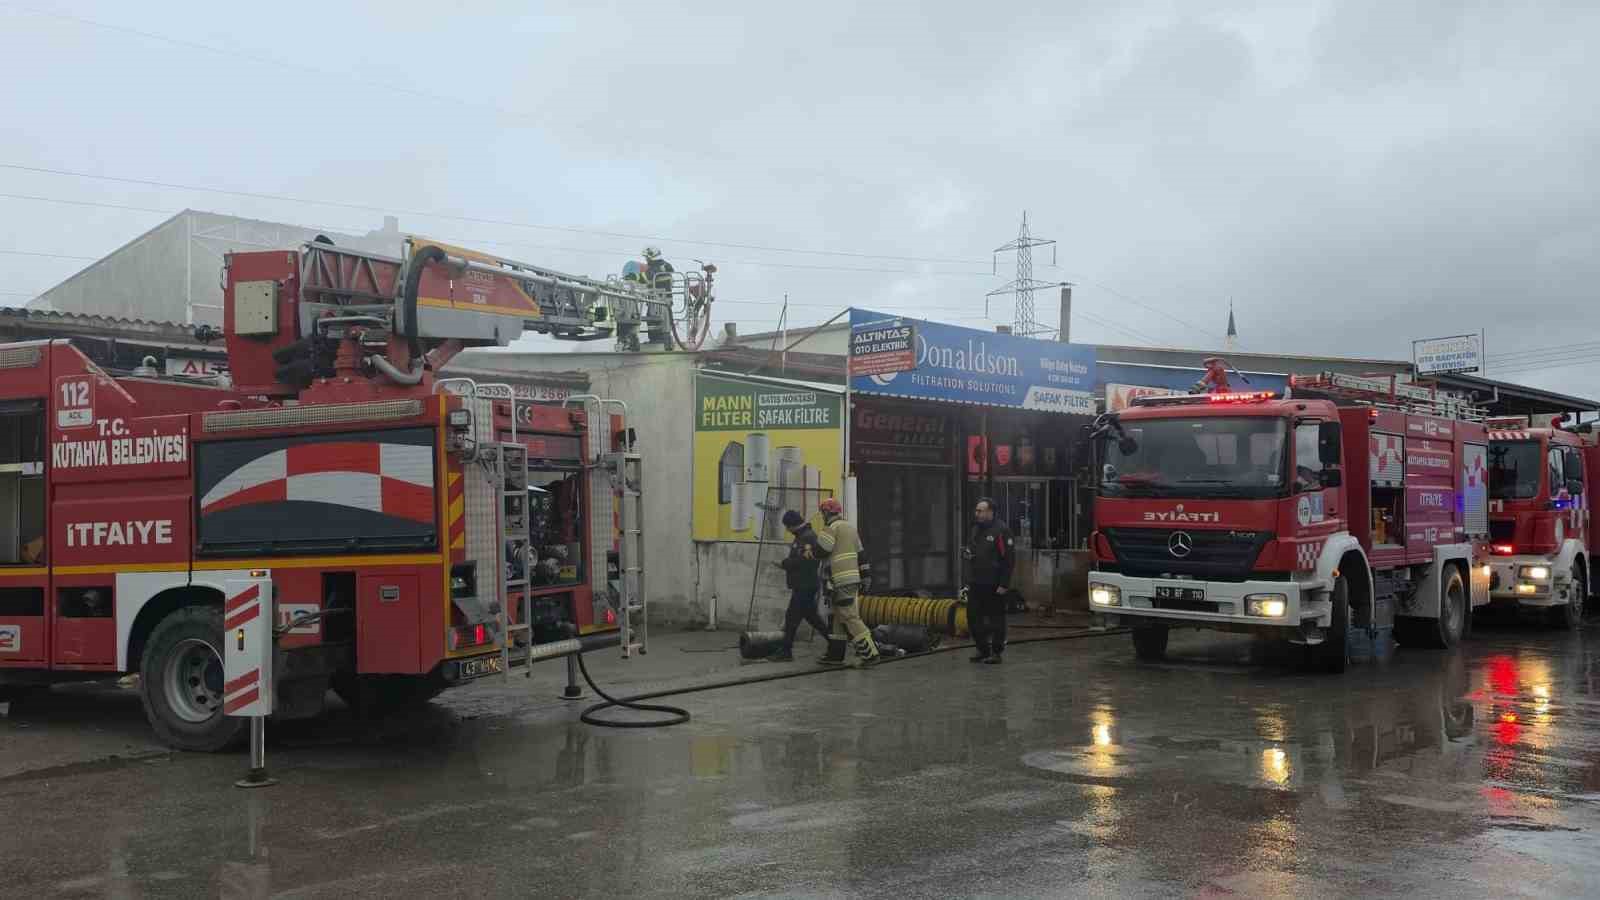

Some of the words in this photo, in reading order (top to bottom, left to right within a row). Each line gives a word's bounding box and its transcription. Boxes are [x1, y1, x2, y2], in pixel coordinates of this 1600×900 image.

[855, 328, 910, 344] ALTINTAŞ
[855, 345, 870, 354] OTO
[911, 374, 964, 390] FILTRATION
[968, 380, 1015, 394] SOLUTIONS
[61, 382, 89, 406] 112
[703, 395, 752, 410] MANN
[97, 418, 130, 436] T.C.
[703, 411, 752, 426] FILTER
[759, 409, 792, 428] ŞAFAK
[795, 408, 830, 424] FİLTRE
[52, 435, 108, 468] KÜTAHYA
[111, 427, 187, 464] BELEDİYESİ
[67, 520, 172, 546] İTFAİYE
